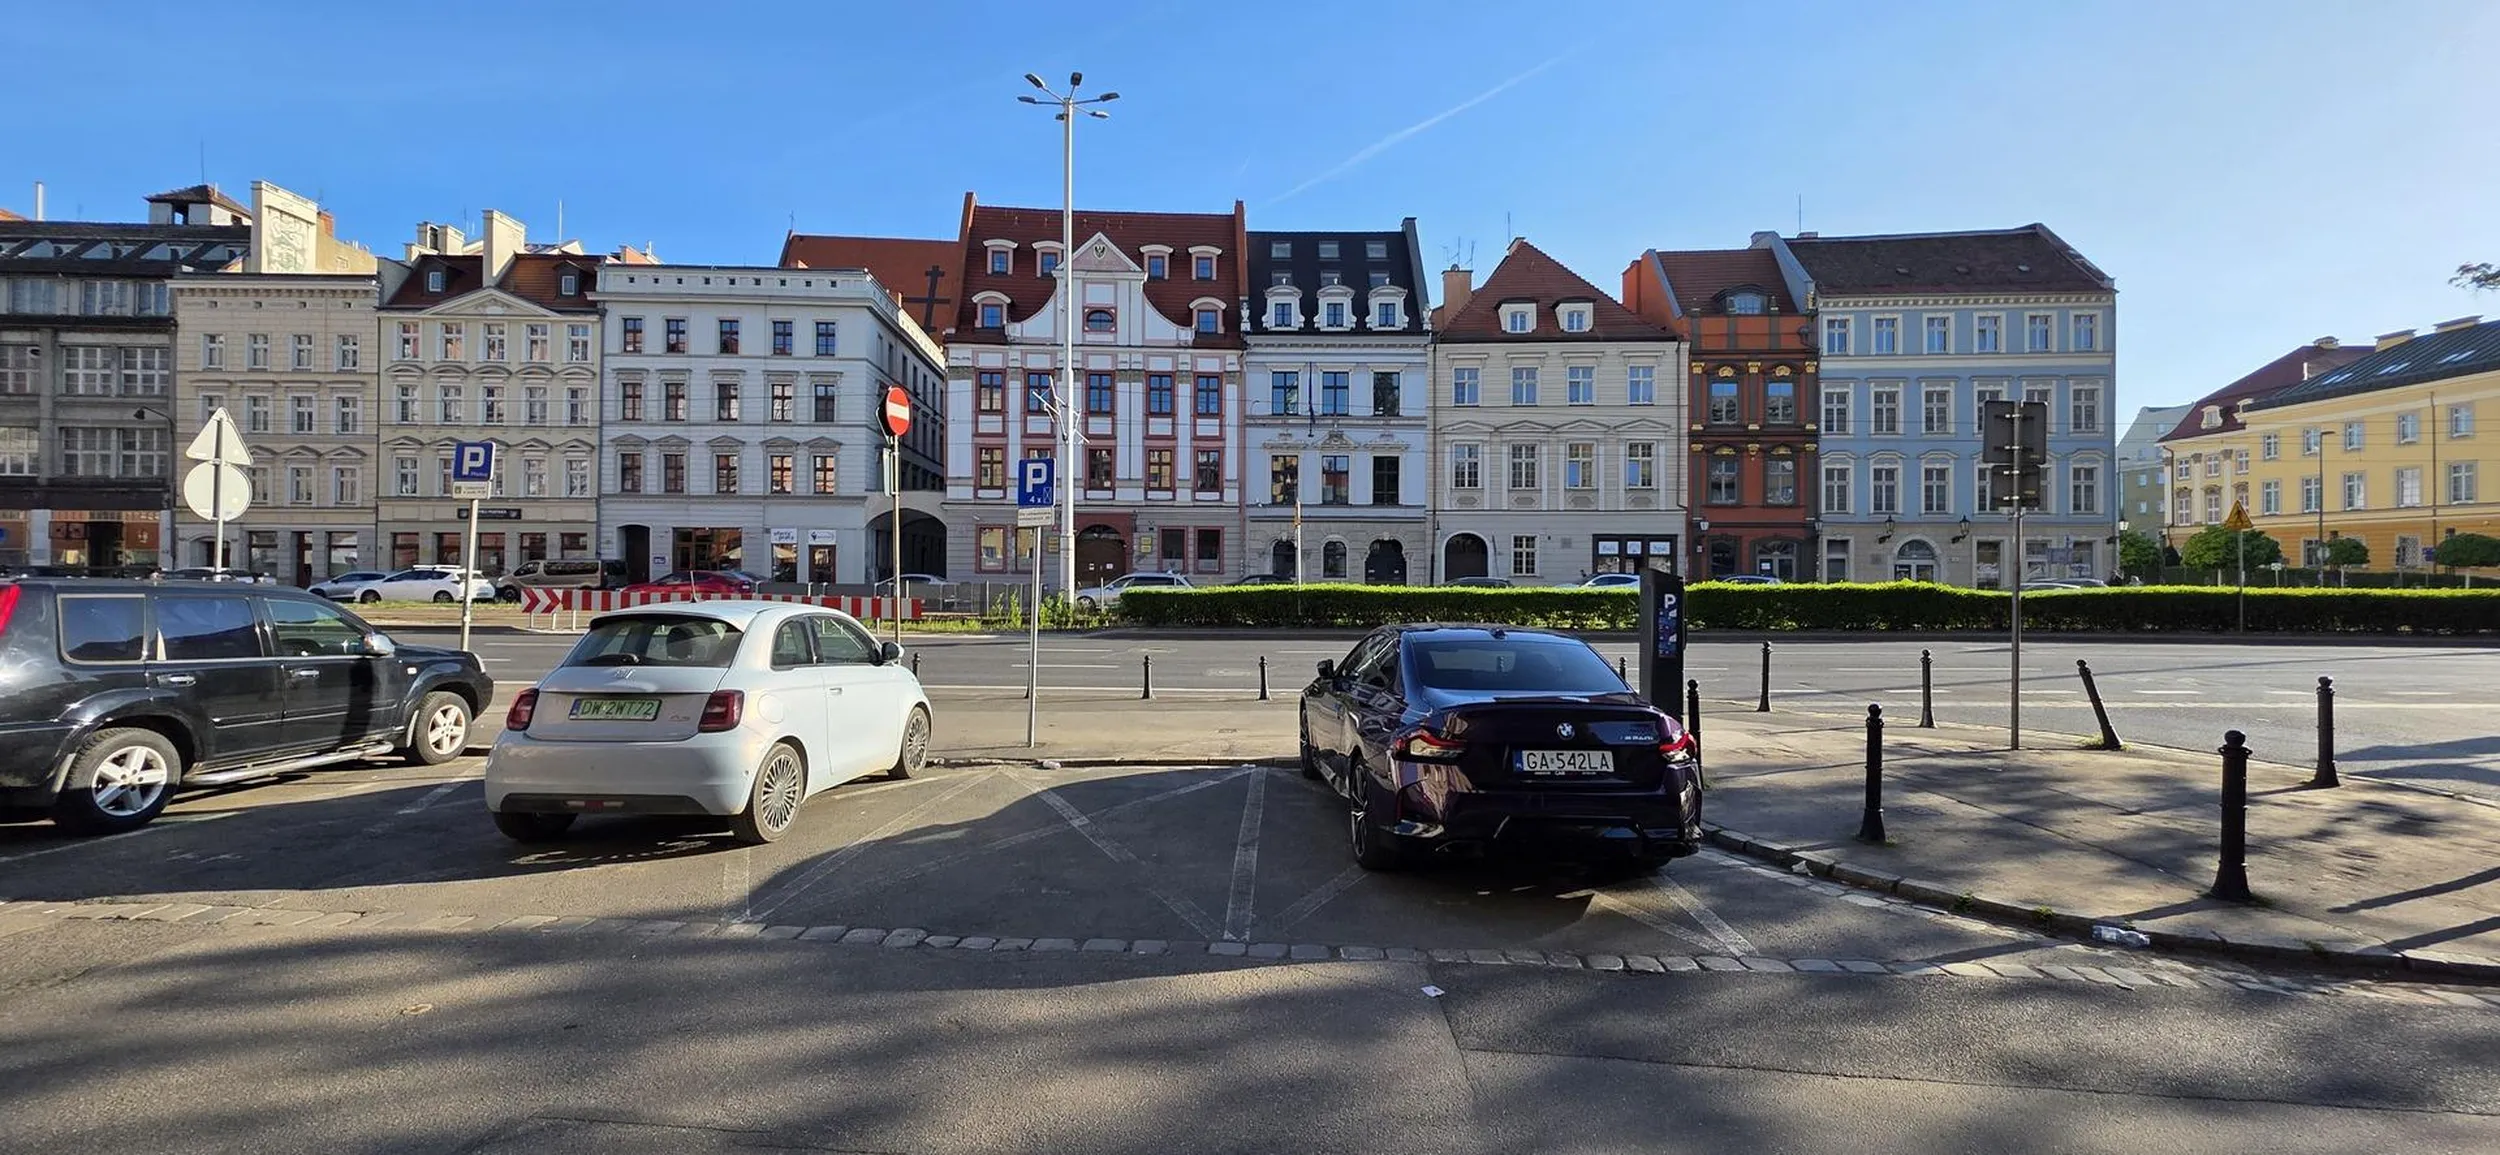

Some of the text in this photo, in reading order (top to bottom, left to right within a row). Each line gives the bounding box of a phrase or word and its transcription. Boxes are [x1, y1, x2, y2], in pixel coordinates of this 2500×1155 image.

[462, 446, 485, 476] P
[1026, 462, 1047, 493] P
[1029, 495, 1035, 504] 4
[1664, 593, 1677, 609] P
[1526, 752, 1610, 770] GA 542LA
